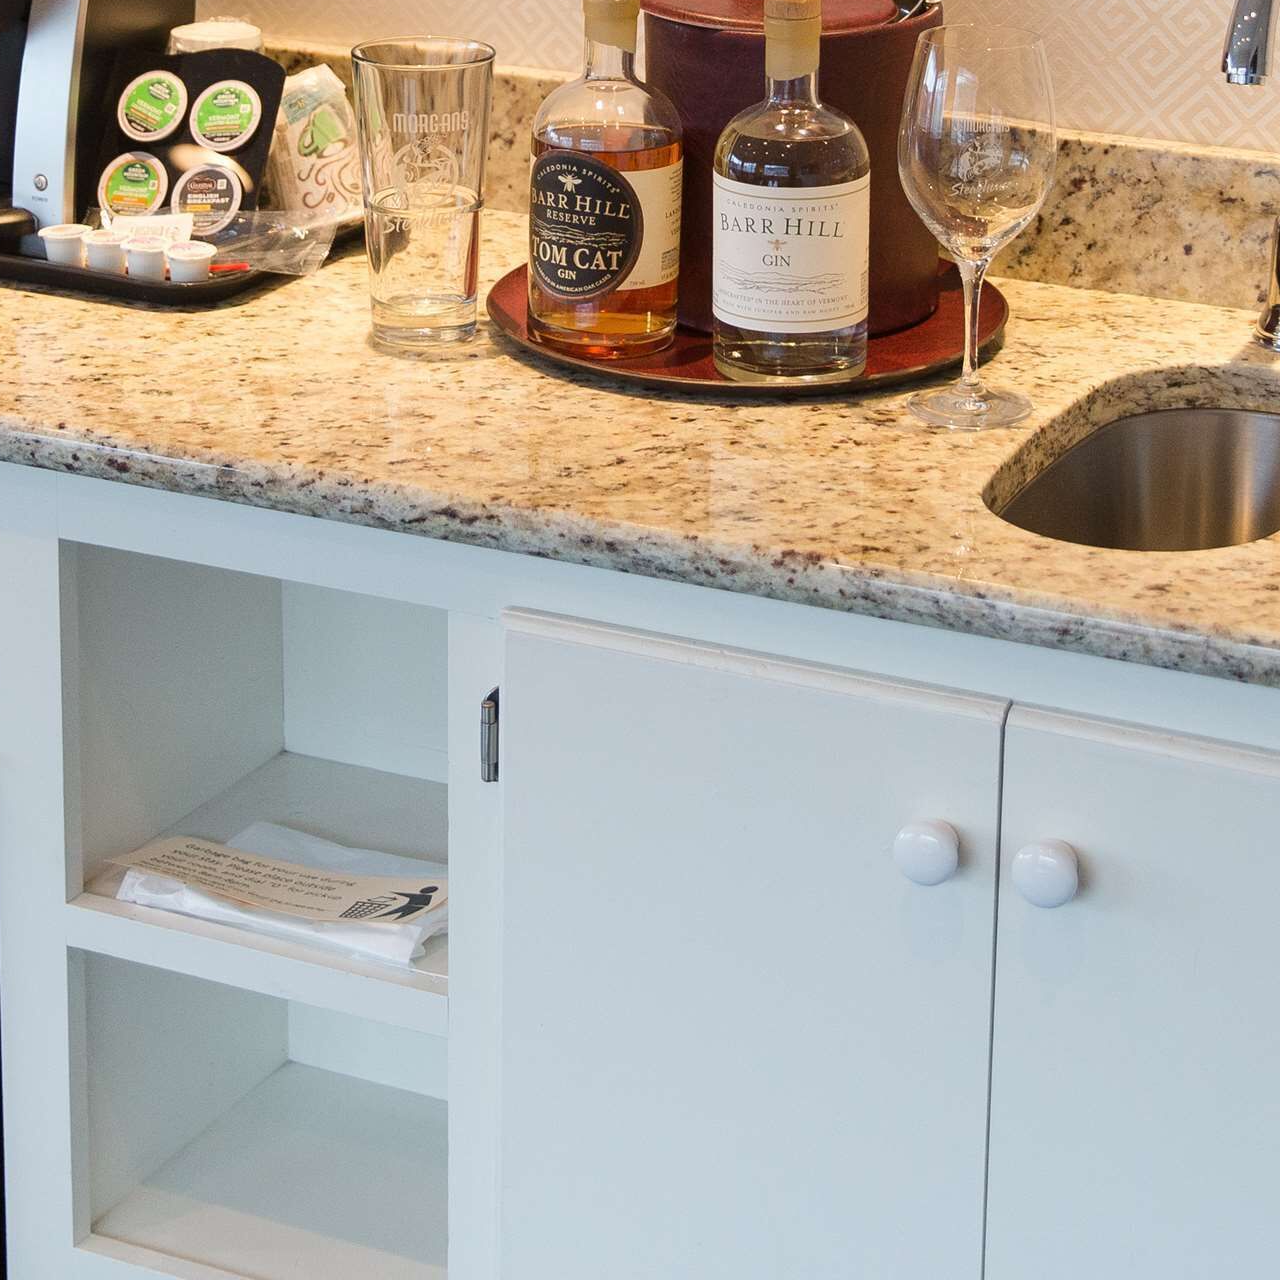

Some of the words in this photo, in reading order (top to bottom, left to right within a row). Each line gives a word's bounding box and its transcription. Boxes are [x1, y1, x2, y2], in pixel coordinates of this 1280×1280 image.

[537, 163, 577, 180] CALEDONIA
[531, 187, 569, 210] BARR
[574, 194, 631, 219] HILL
[727, 199, 785, 213] CALEDONIA
[546, 208, 597, 226] RESERVE
[720, 212, 775, 235] BARR
[783, 217, 844, 238] HILL
[532, 234, 568, 266] TOM
[572, 248, 623, 271] CAT
[762, 254, 792, 268] GIN
[556, 283, 583, 293] AMERICAN
[583, 283, 596, 291] OAK
[595, 273, 612, 287] CASKS
[557, 268, 577, 281] GIN
[765, 298, 779, 306] THE
[781, 298, 805, 306] HEART
[807, 298, 817, 306] OF
[818, 294, 848, 305] VERMONT
[185, 843, 231, 859] Garbage
[232, 856, 251, 866] bag
[271, 866, 298, 875] your
[173, 849, 199, 859] your
[262, 872, 294, 883] place
[294, 880, 337, 891] outside
